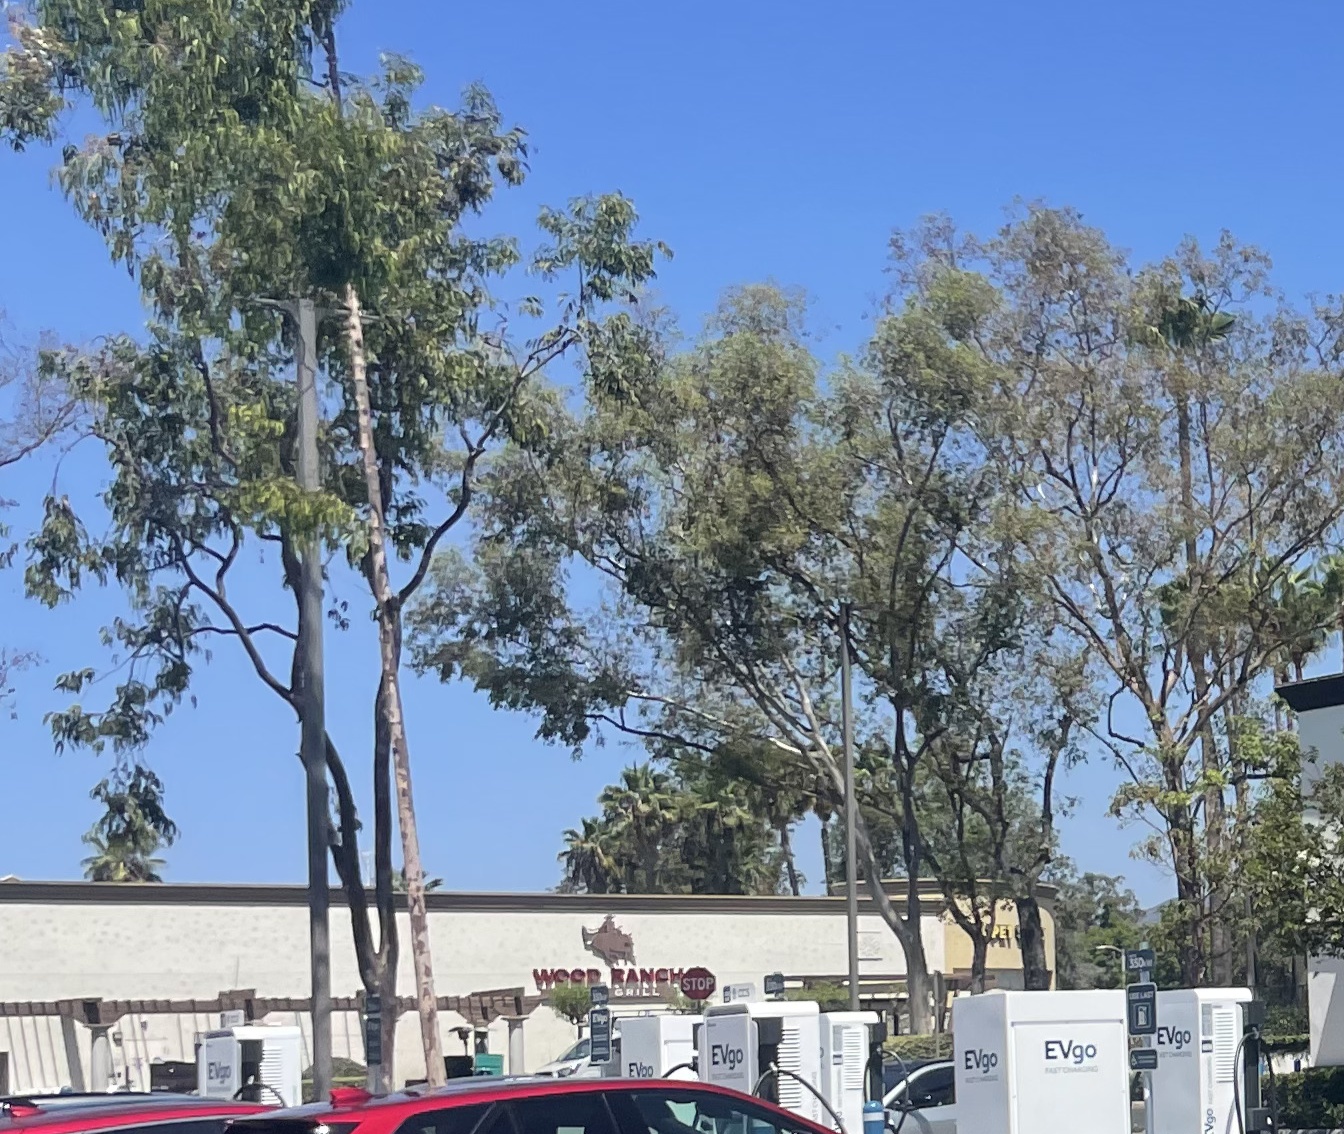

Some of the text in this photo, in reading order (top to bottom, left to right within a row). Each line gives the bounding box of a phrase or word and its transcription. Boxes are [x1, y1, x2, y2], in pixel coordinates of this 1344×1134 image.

[533, 967, 684, 986] WOOD RANCH
[682, 977, 715, 991] STOP
[614, 987, 661, 997] GRILL
[1157, 1026, 1191, 1050] EVgo
[712, 1043, 744, 1070] EVgo
[964, 1049, 998, 1073] EVgo
[1045, 1039, 1097, 1064] EVgo
